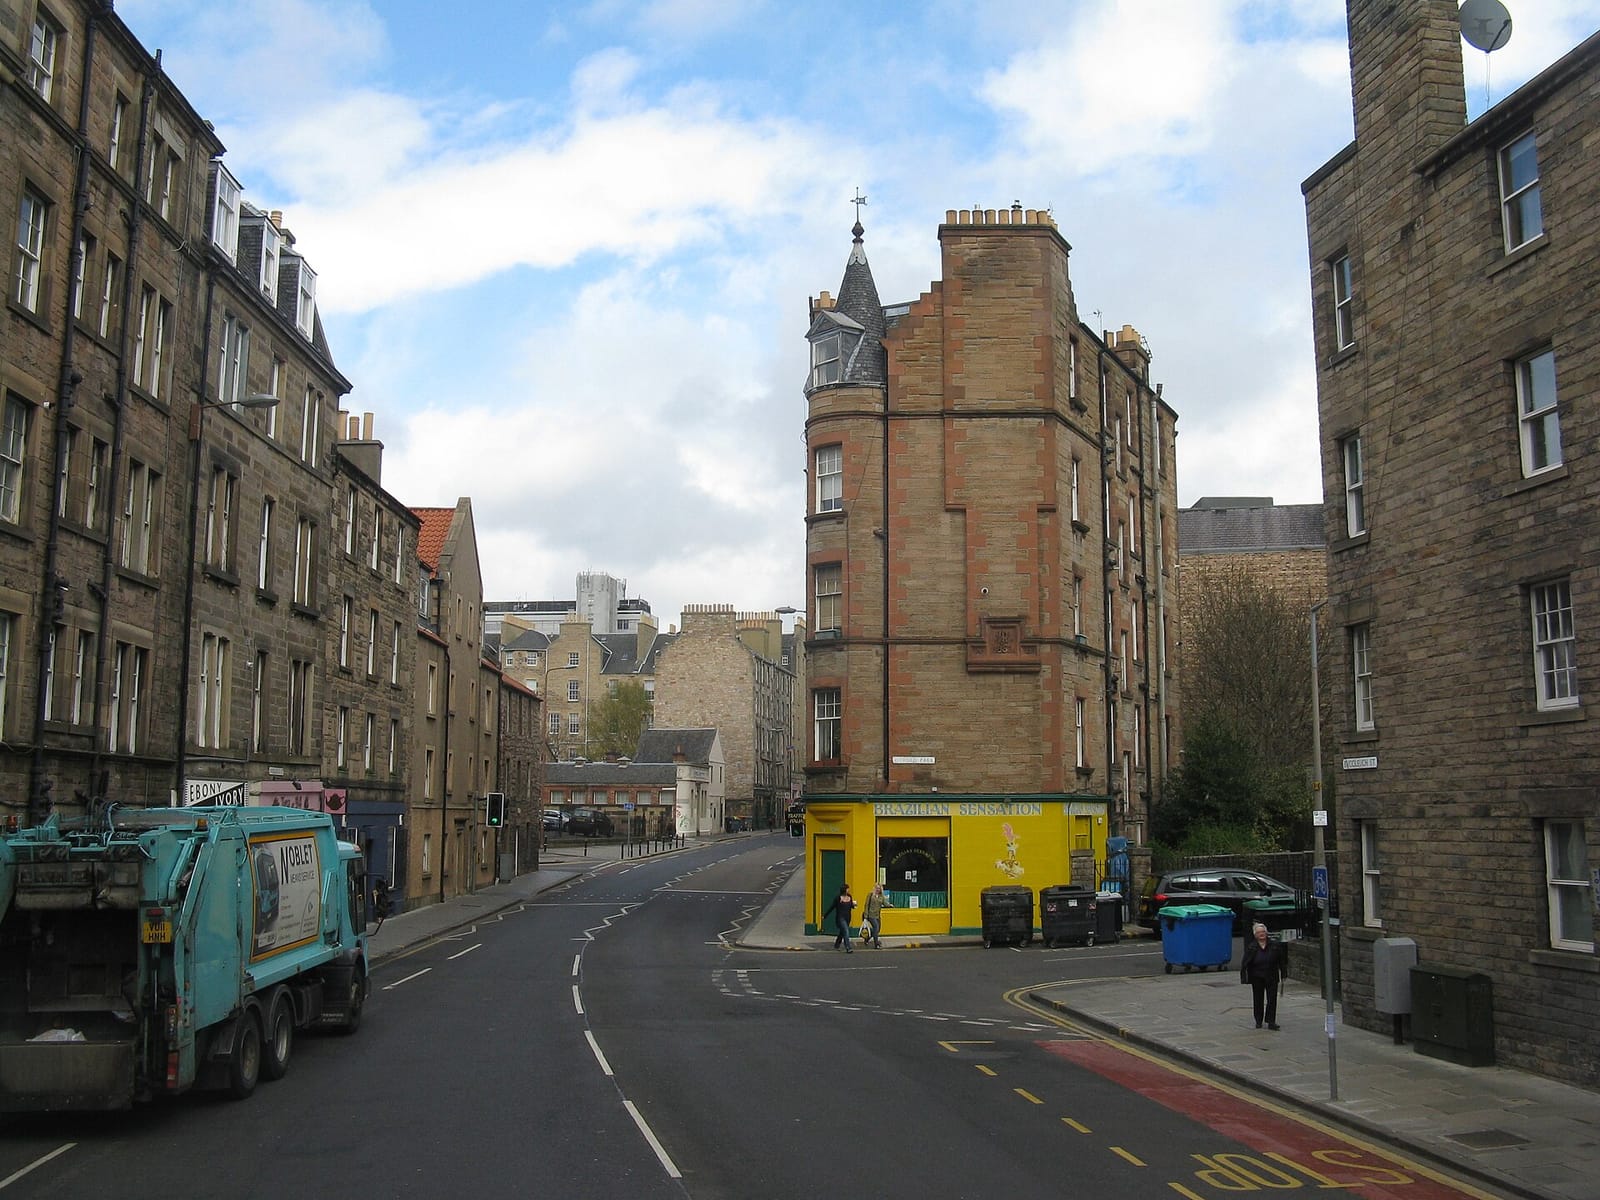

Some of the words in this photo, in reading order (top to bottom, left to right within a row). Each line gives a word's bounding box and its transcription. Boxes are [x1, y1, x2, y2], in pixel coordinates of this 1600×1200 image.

[189, 782, 223, 802] EBONY
[215, 787, 244, 806] IVORY
[875, 803, 950, 815] BRAZILIAN
[959, 803, 1041, 815] SENSATION
[280, 844, 314, 885] NOBLET
[1190, 1150, 1416, 1191] STOP
